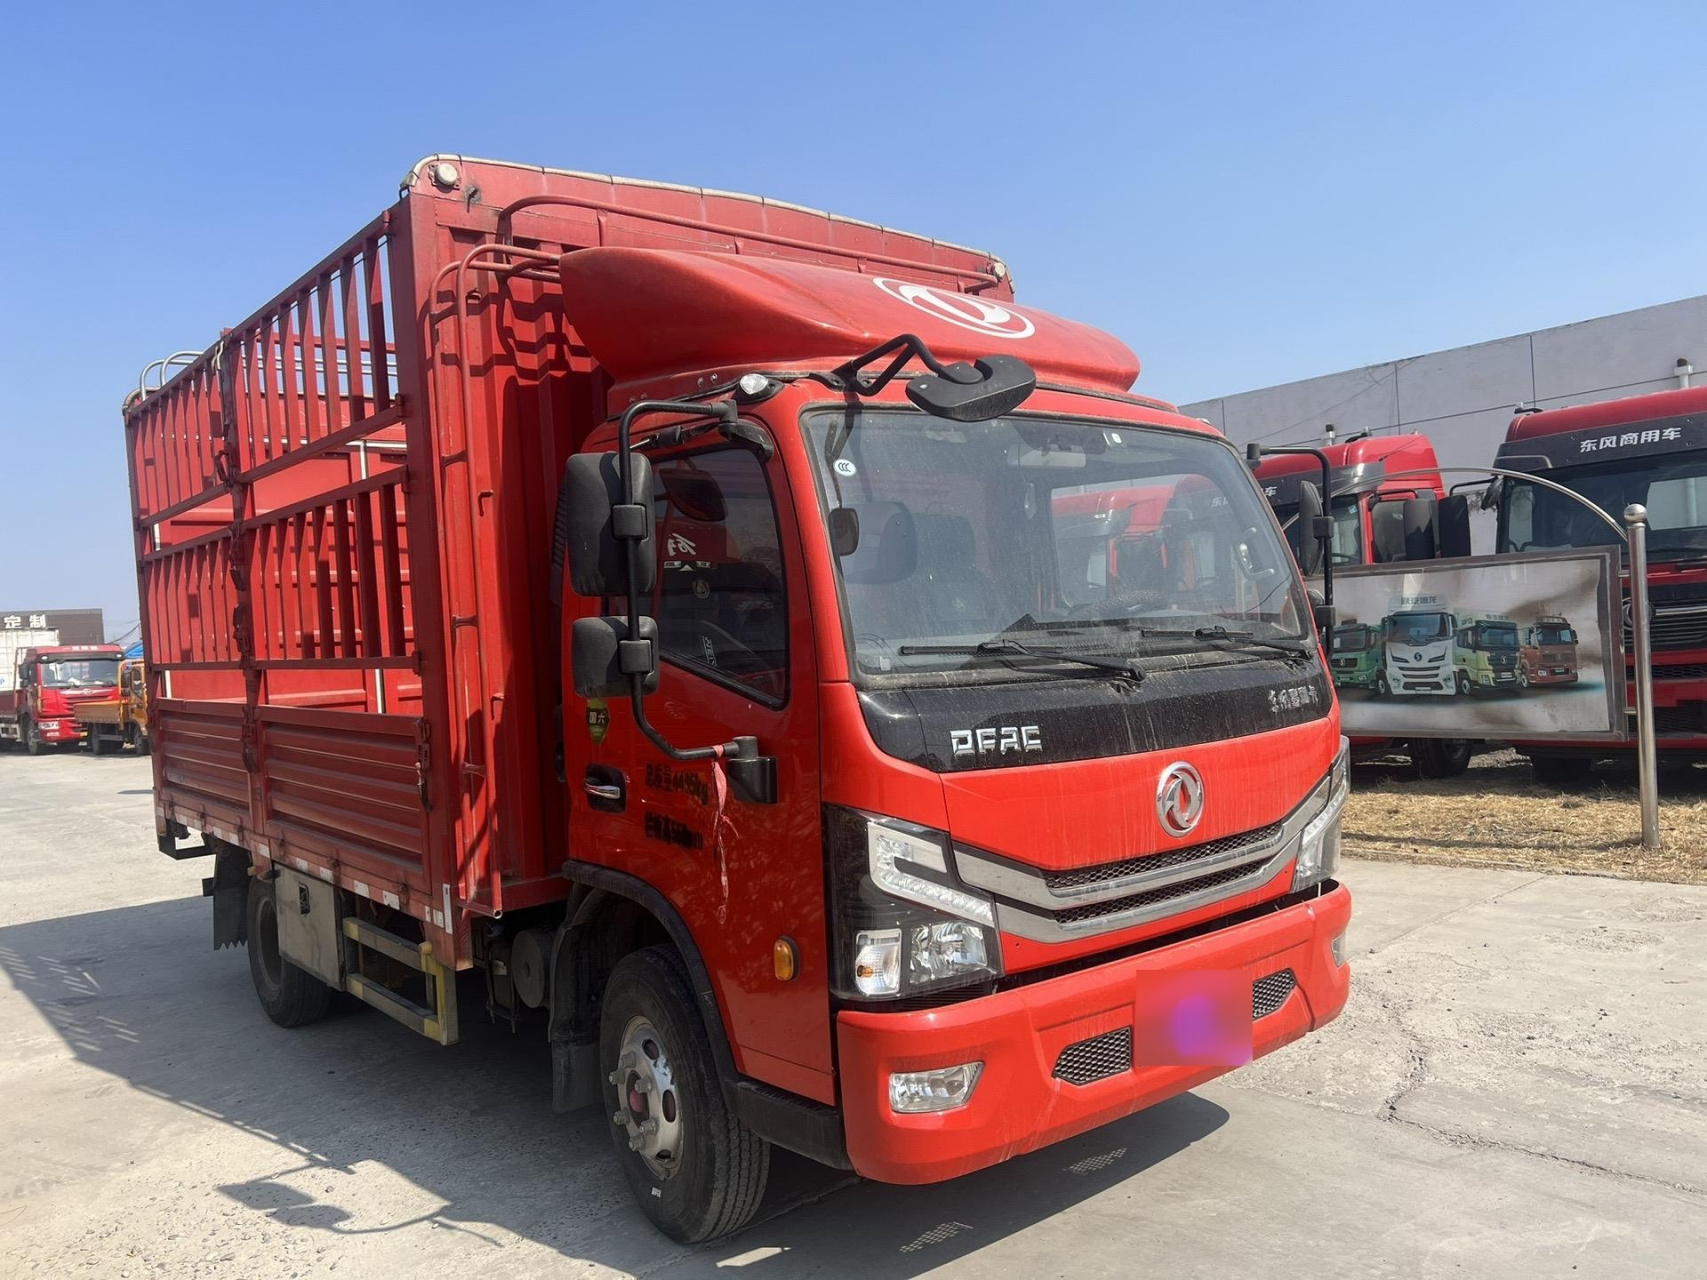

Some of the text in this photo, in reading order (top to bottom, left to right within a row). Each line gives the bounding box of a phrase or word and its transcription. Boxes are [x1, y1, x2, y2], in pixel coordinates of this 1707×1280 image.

[1580, 427, 1682, 453] 东风商用车
[3, 614, 47, 629] 定制
[589, 711, 606, 724] 国六
[950, 724, 1044, 756] DFAC
